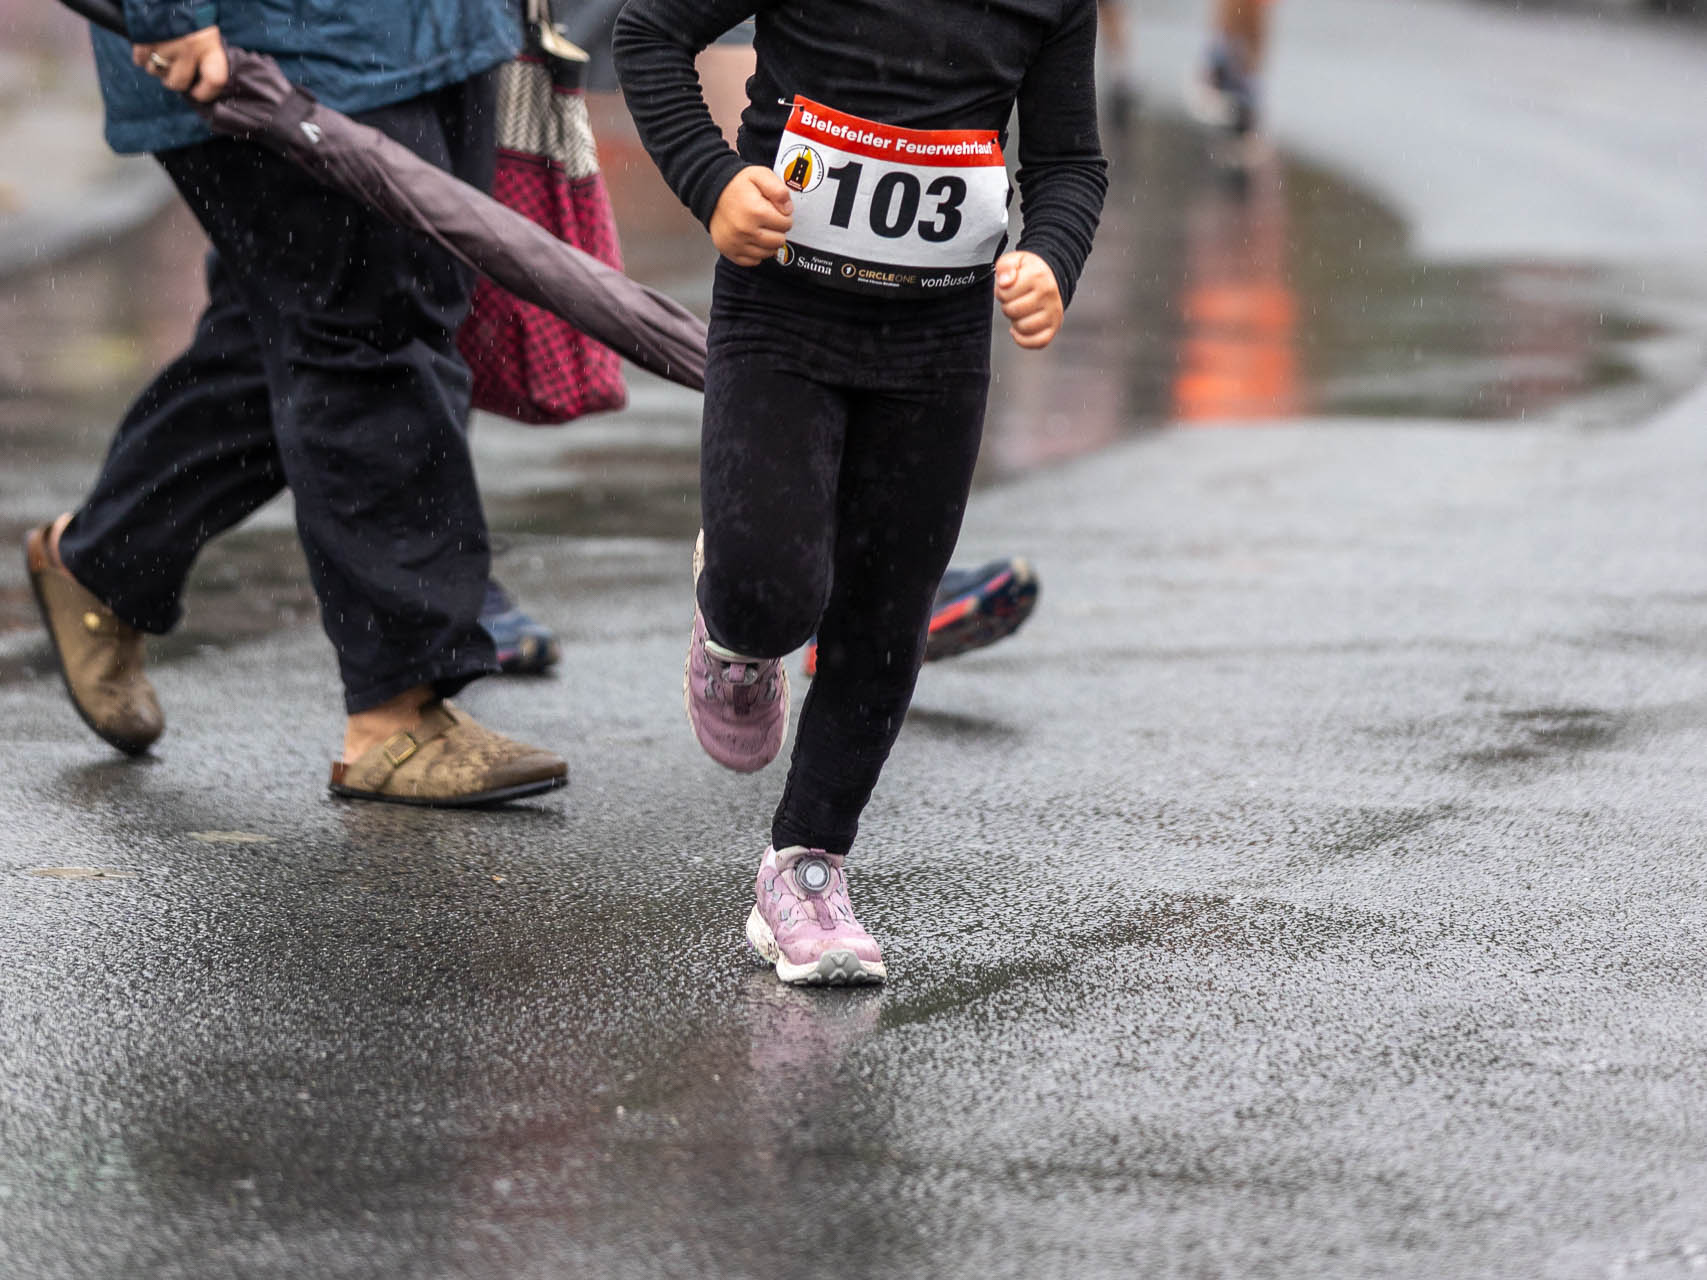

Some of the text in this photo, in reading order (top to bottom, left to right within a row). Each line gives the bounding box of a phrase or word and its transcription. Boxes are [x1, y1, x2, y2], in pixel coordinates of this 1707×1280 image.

[801, 110, 892, 149] Bielefelder
[826, 160, 967, 243] 103
[797, 256, 832, 276] Sauna
[921, 271, 975, 288] vonBusch
